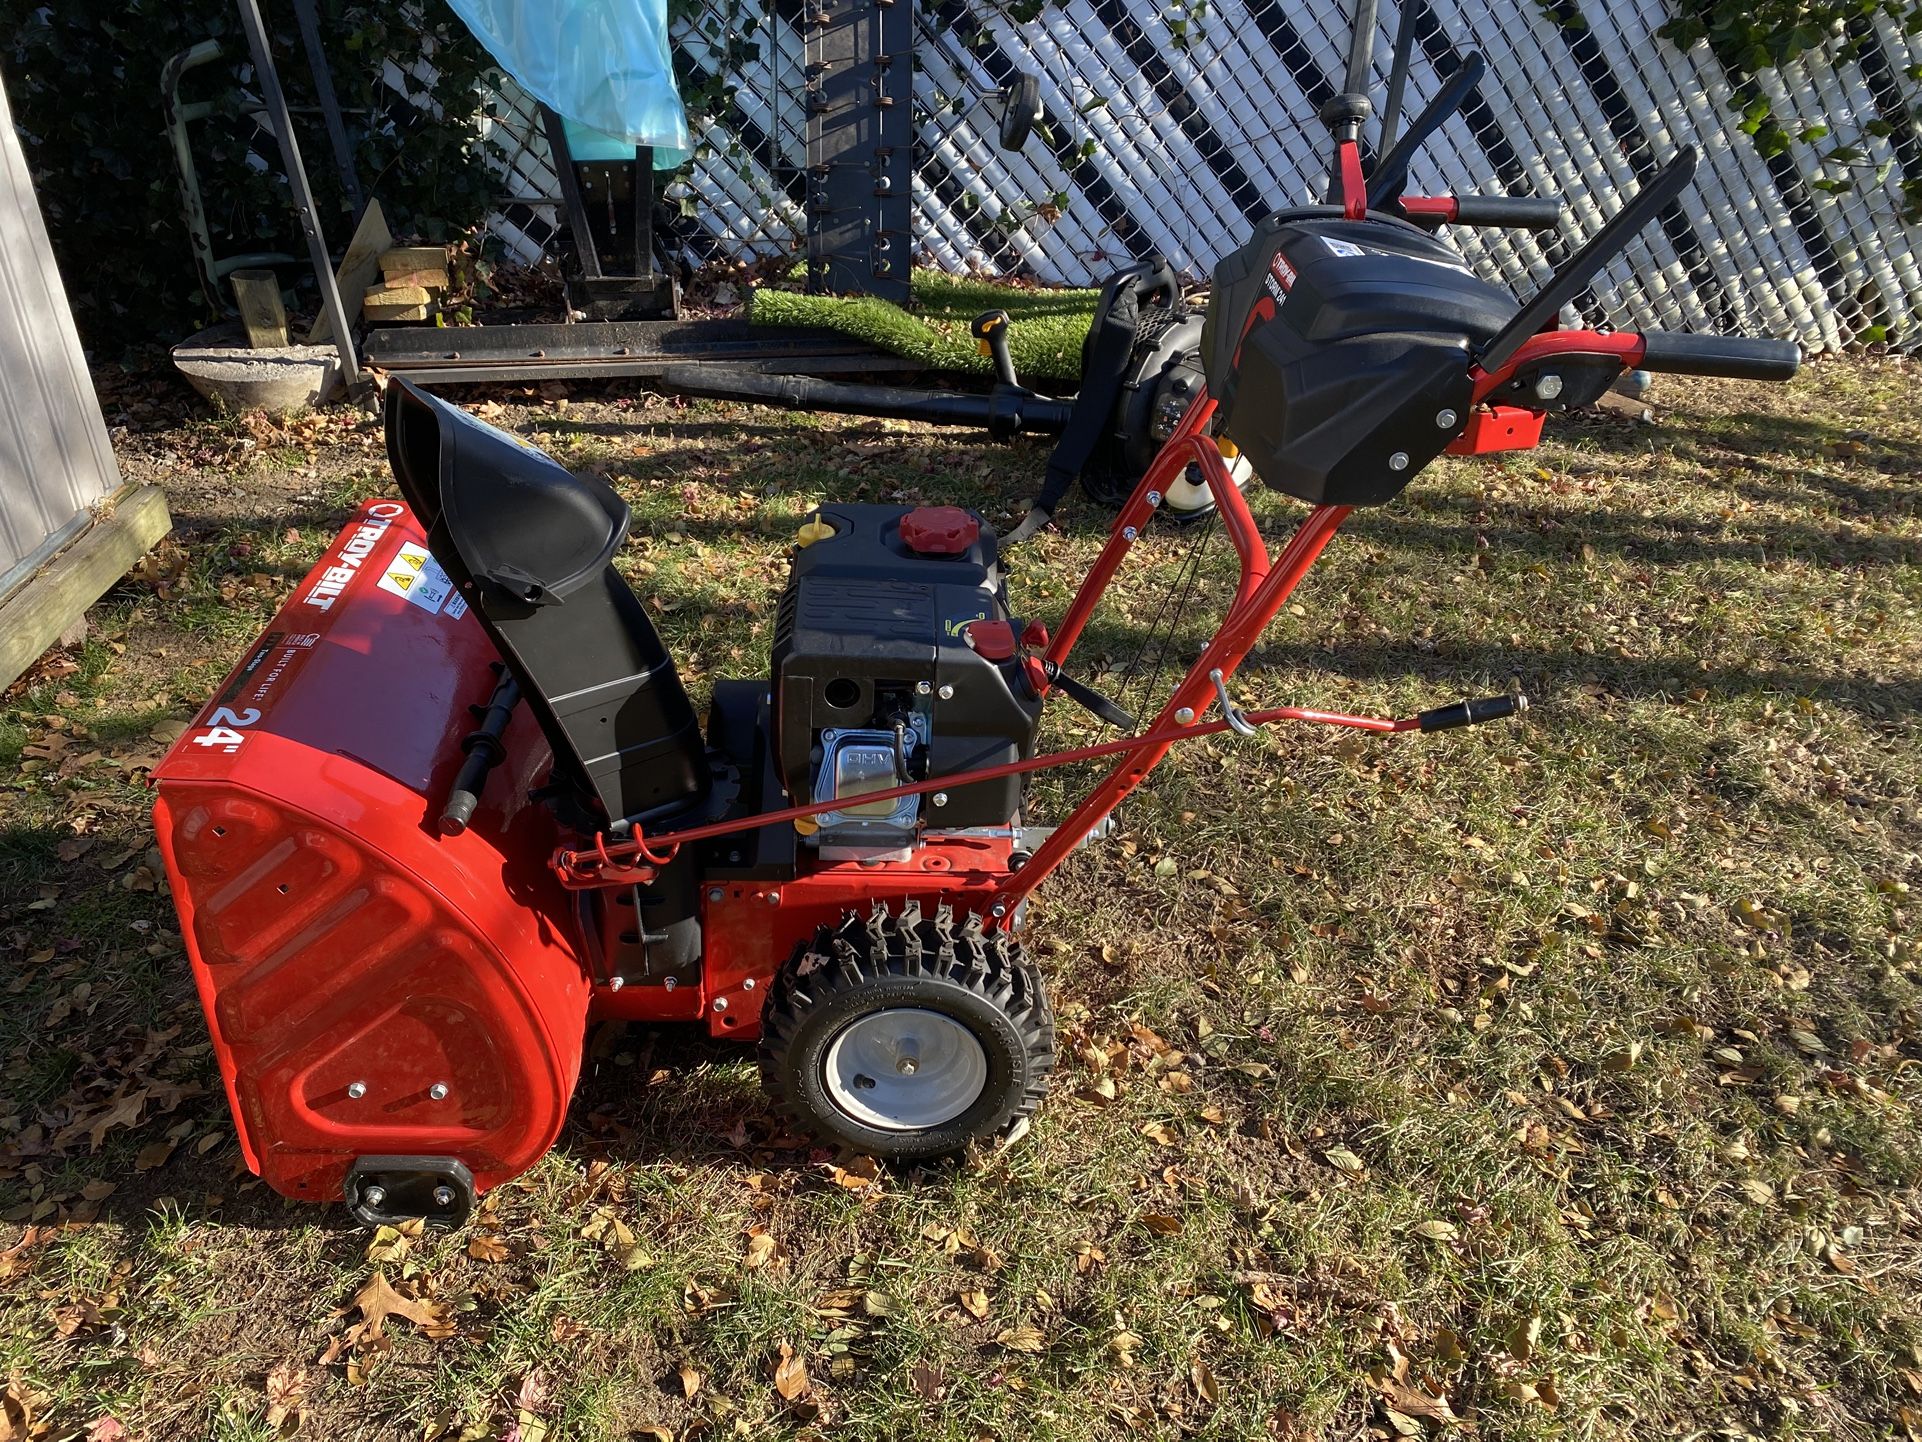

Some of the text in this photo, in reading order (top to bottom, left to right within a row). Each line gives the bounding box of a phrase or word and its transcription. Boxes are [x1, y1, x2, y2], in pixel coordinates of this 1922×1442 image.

[1276, 290, 1287, 307] 241
[303, 518, 393, 611] TROY-BILT
[276, 649, 297, 667] BUILT
[265, 668, 282, 682] FOR
[192, 706, 262, 753] 24"
[847, 752, 890, 765] OHV
[990, 1016, 1023, 1088] CARLISLE
